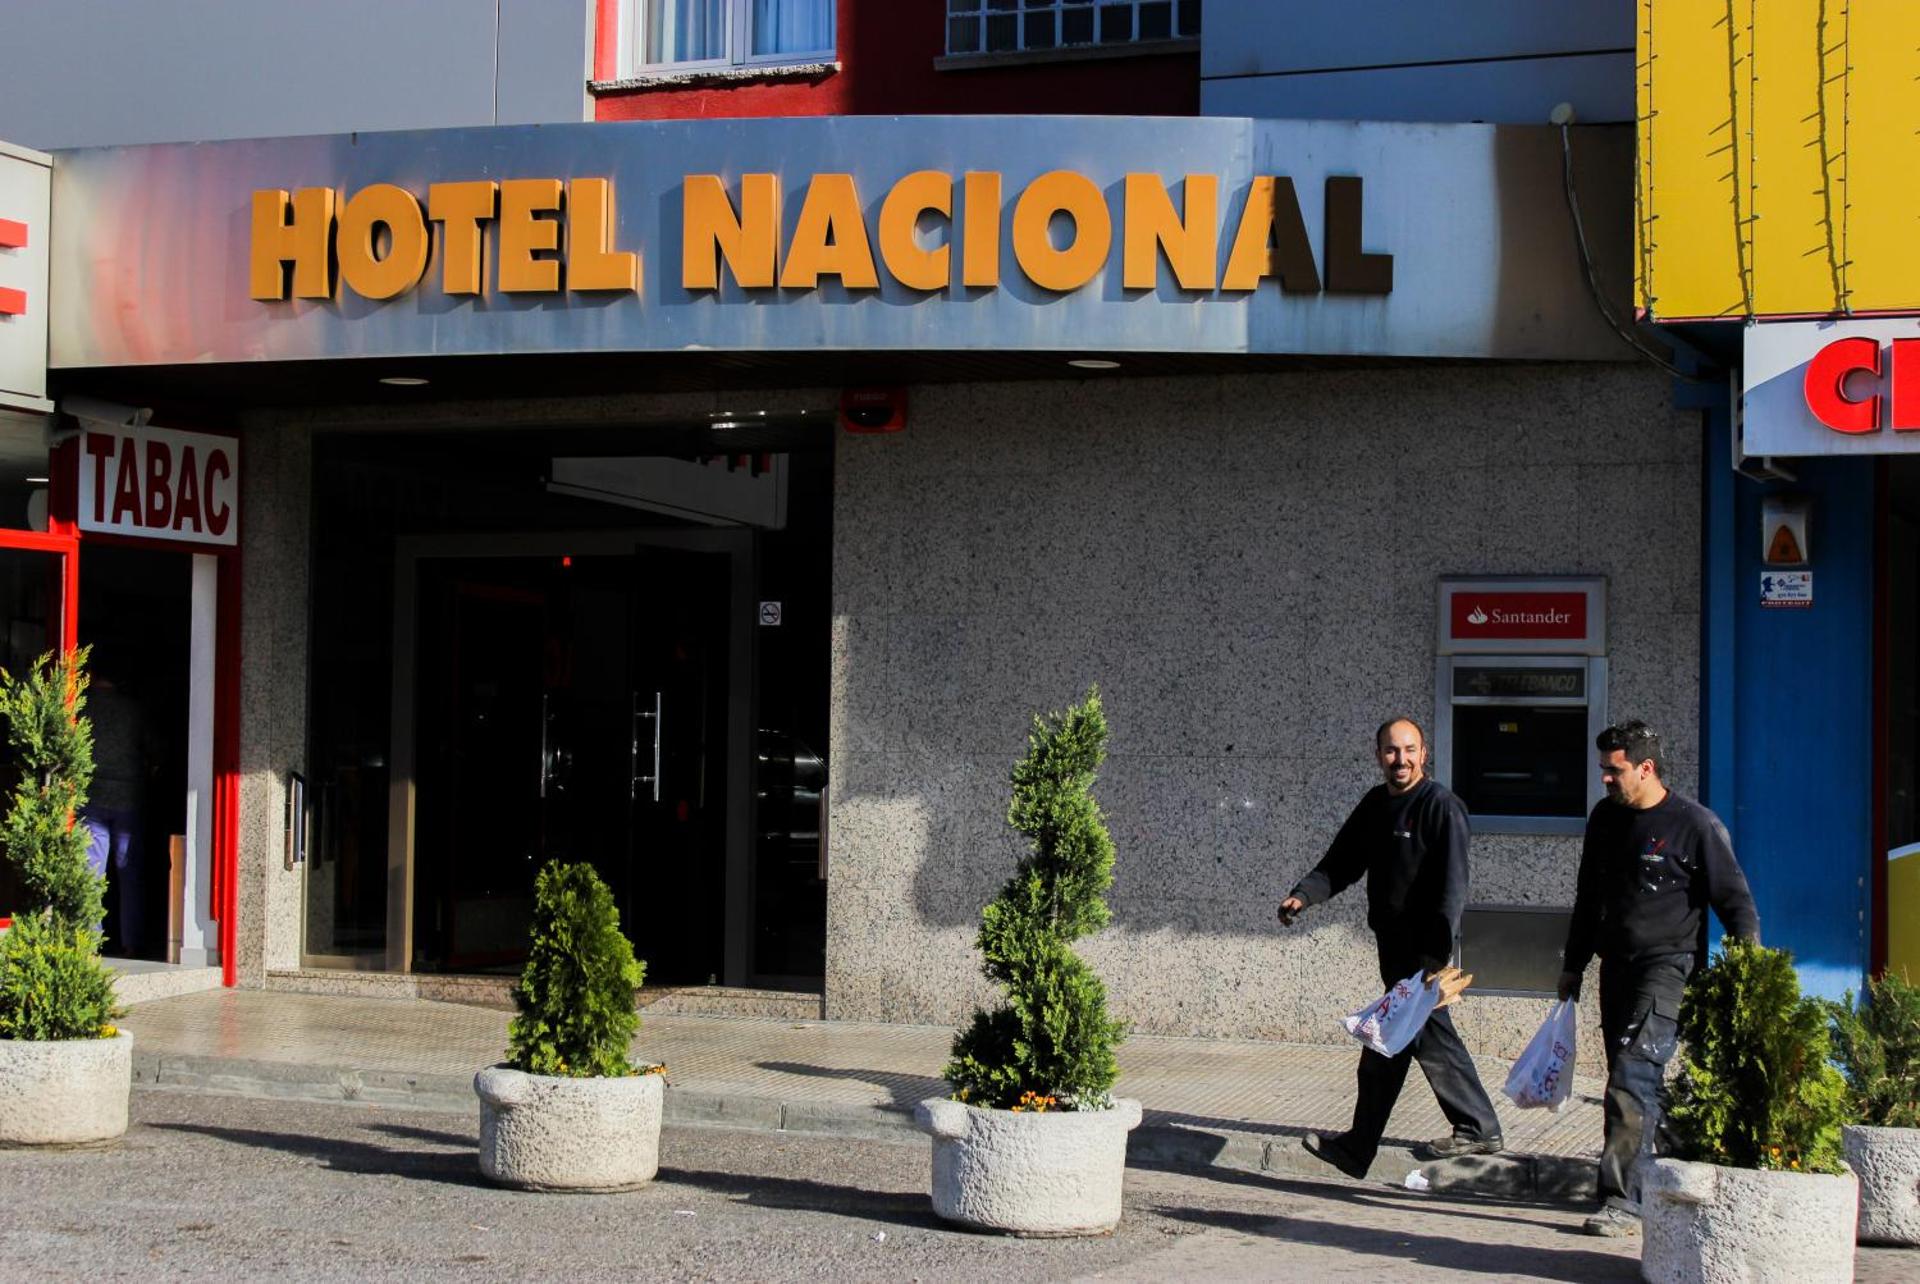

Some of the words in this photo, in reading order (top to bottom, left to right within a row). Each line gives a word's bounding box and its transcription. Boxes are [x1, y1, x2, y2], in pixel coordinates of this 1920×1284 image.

[249, 177, 642, 302] HOTEL
[681, 169, 1394, 294] NACIONAL
[1804, 336, 1920, 435] C
[86, 431, 231, 537] TABAC
[1492, 608, 1571, 625] Santander
